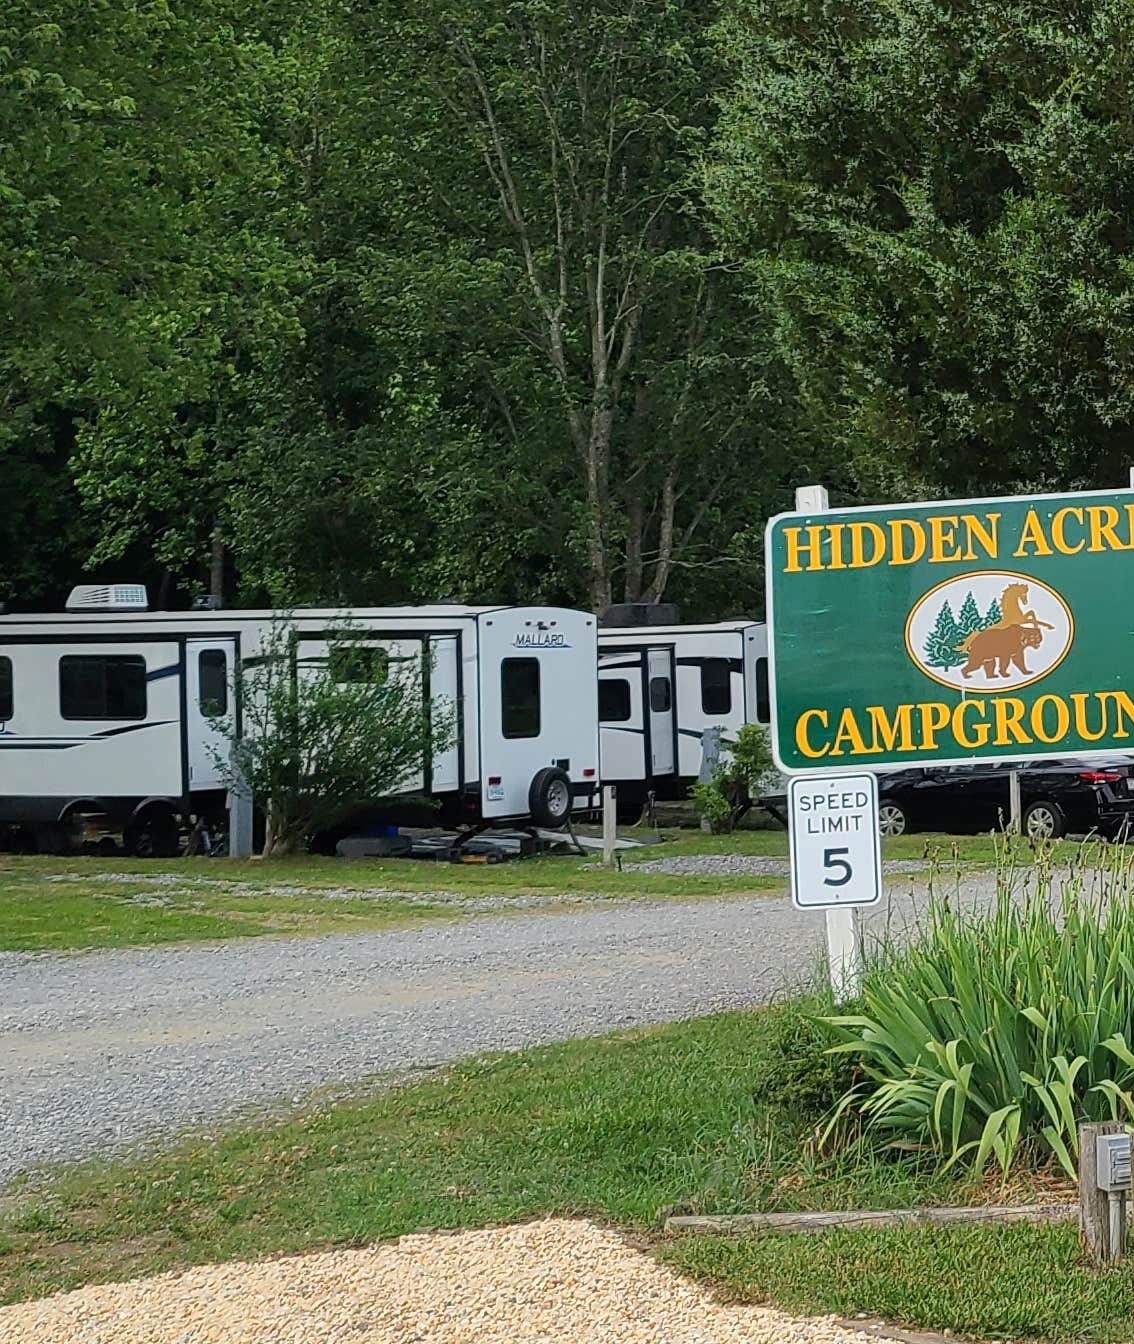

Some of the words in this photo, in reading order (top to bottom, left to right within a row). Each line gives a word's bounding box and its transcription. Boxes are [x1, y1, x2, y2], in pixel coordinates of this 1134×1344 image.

[782, 512, 1000, 573] HIDDEN
[516, 633, 564, 646] MALLARD
[799, 792, 868, 812] SPEED
[807, 814, 863, 834] LIMIT
[823, 847, 853, 887] 5
